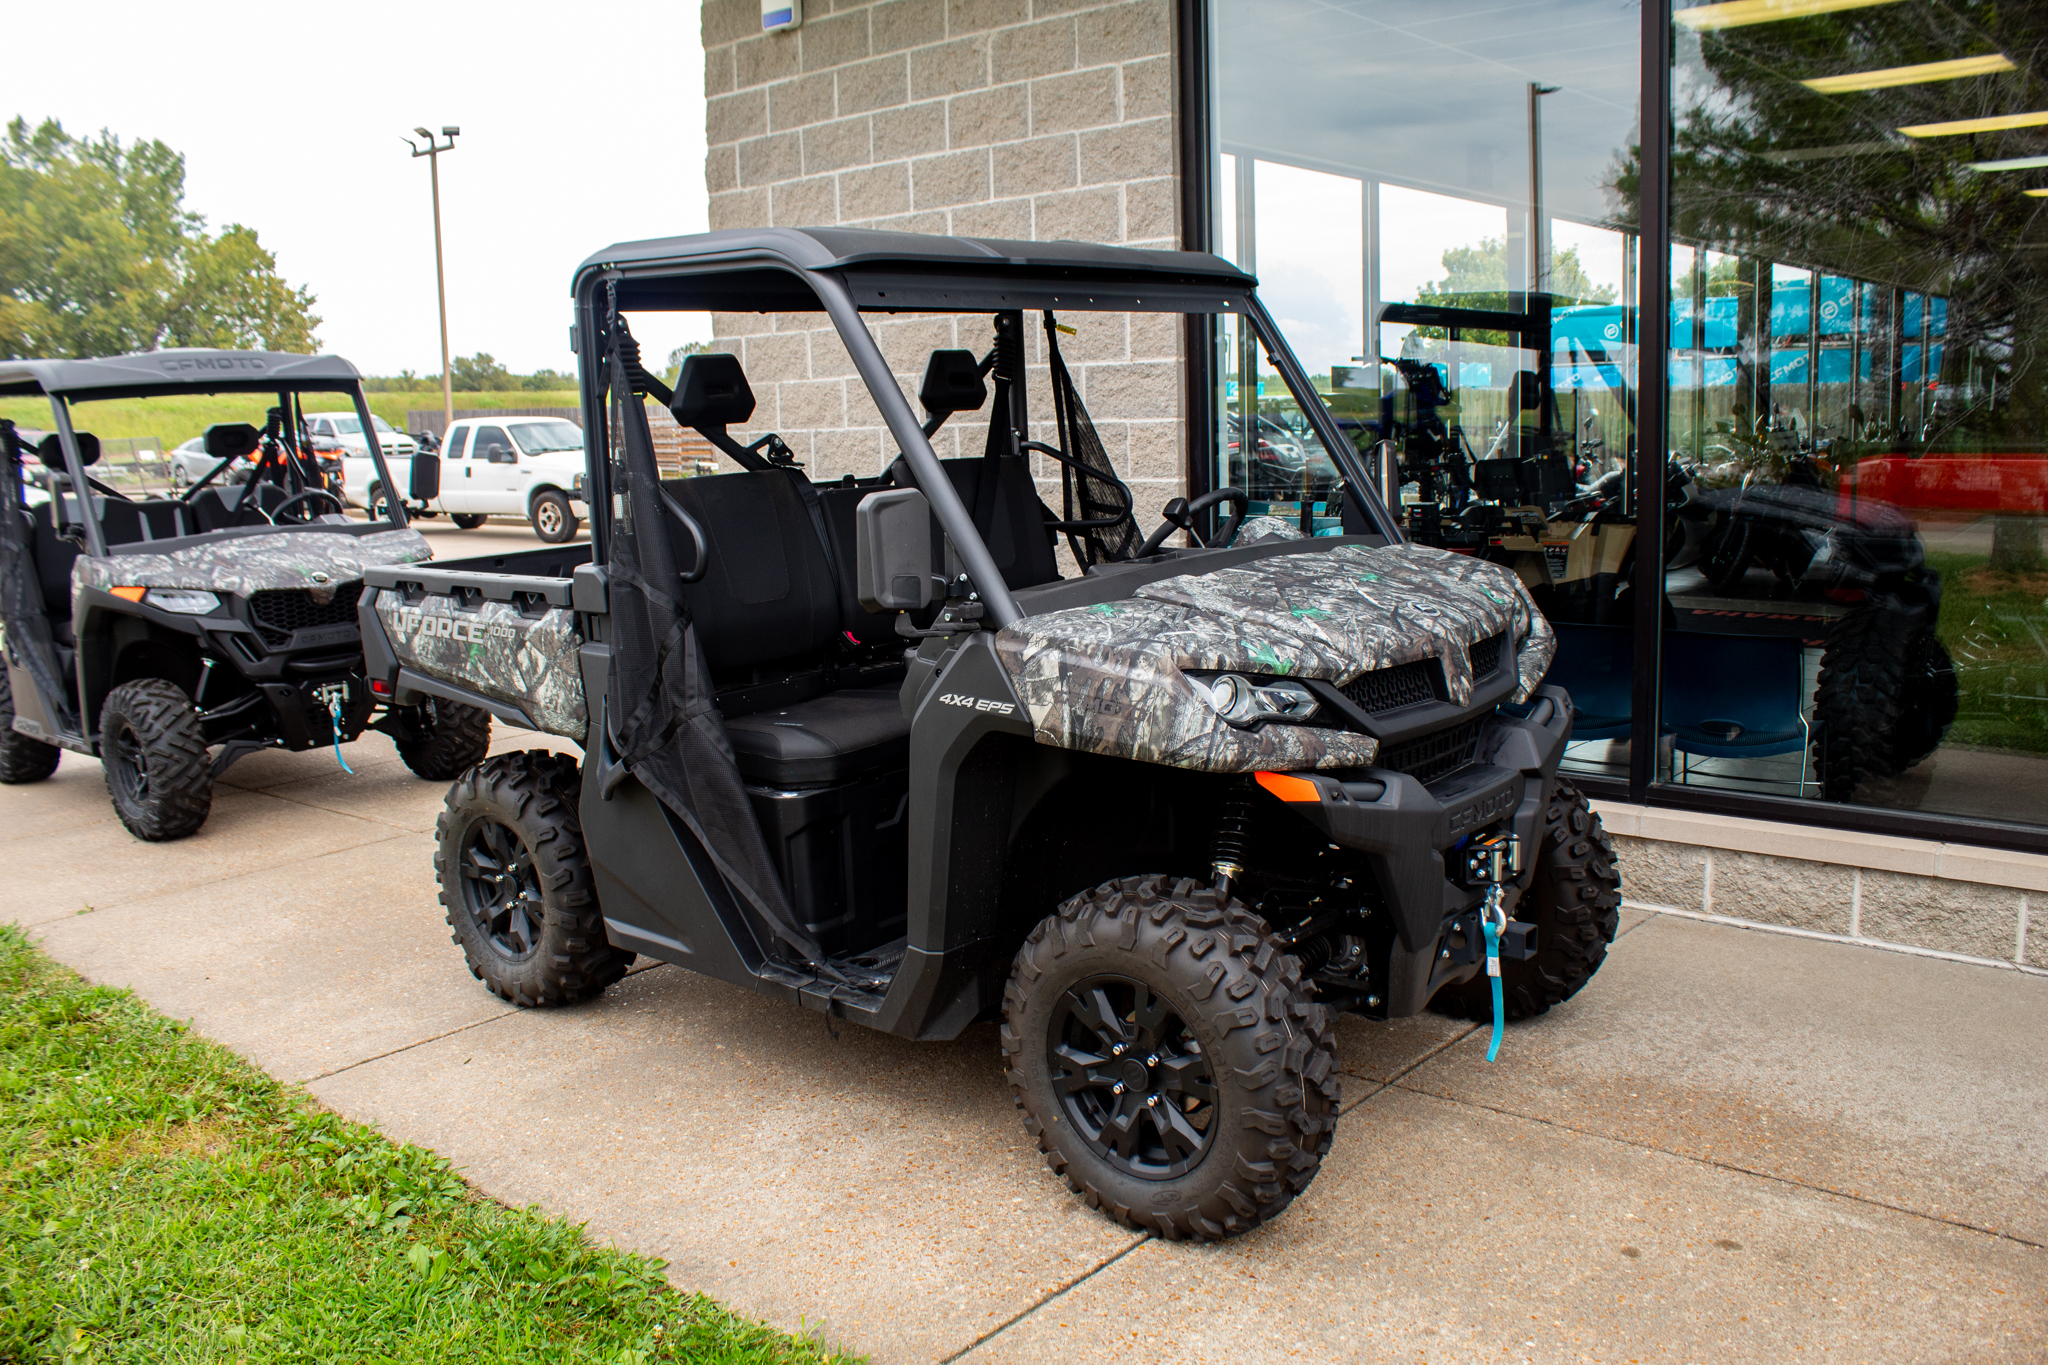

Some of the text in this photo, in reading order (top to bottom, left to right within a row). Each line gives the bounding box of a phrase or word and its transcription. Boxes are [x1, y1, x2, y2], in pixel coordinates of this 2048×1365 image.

[159, 357, 266, 371] CFMOTO
[392, 612, 516, 645] UFORCE 1000
[939, 693, 1015, 715] 4X4 EPS
[1449, 786, 1514, 834] CFMOTO
